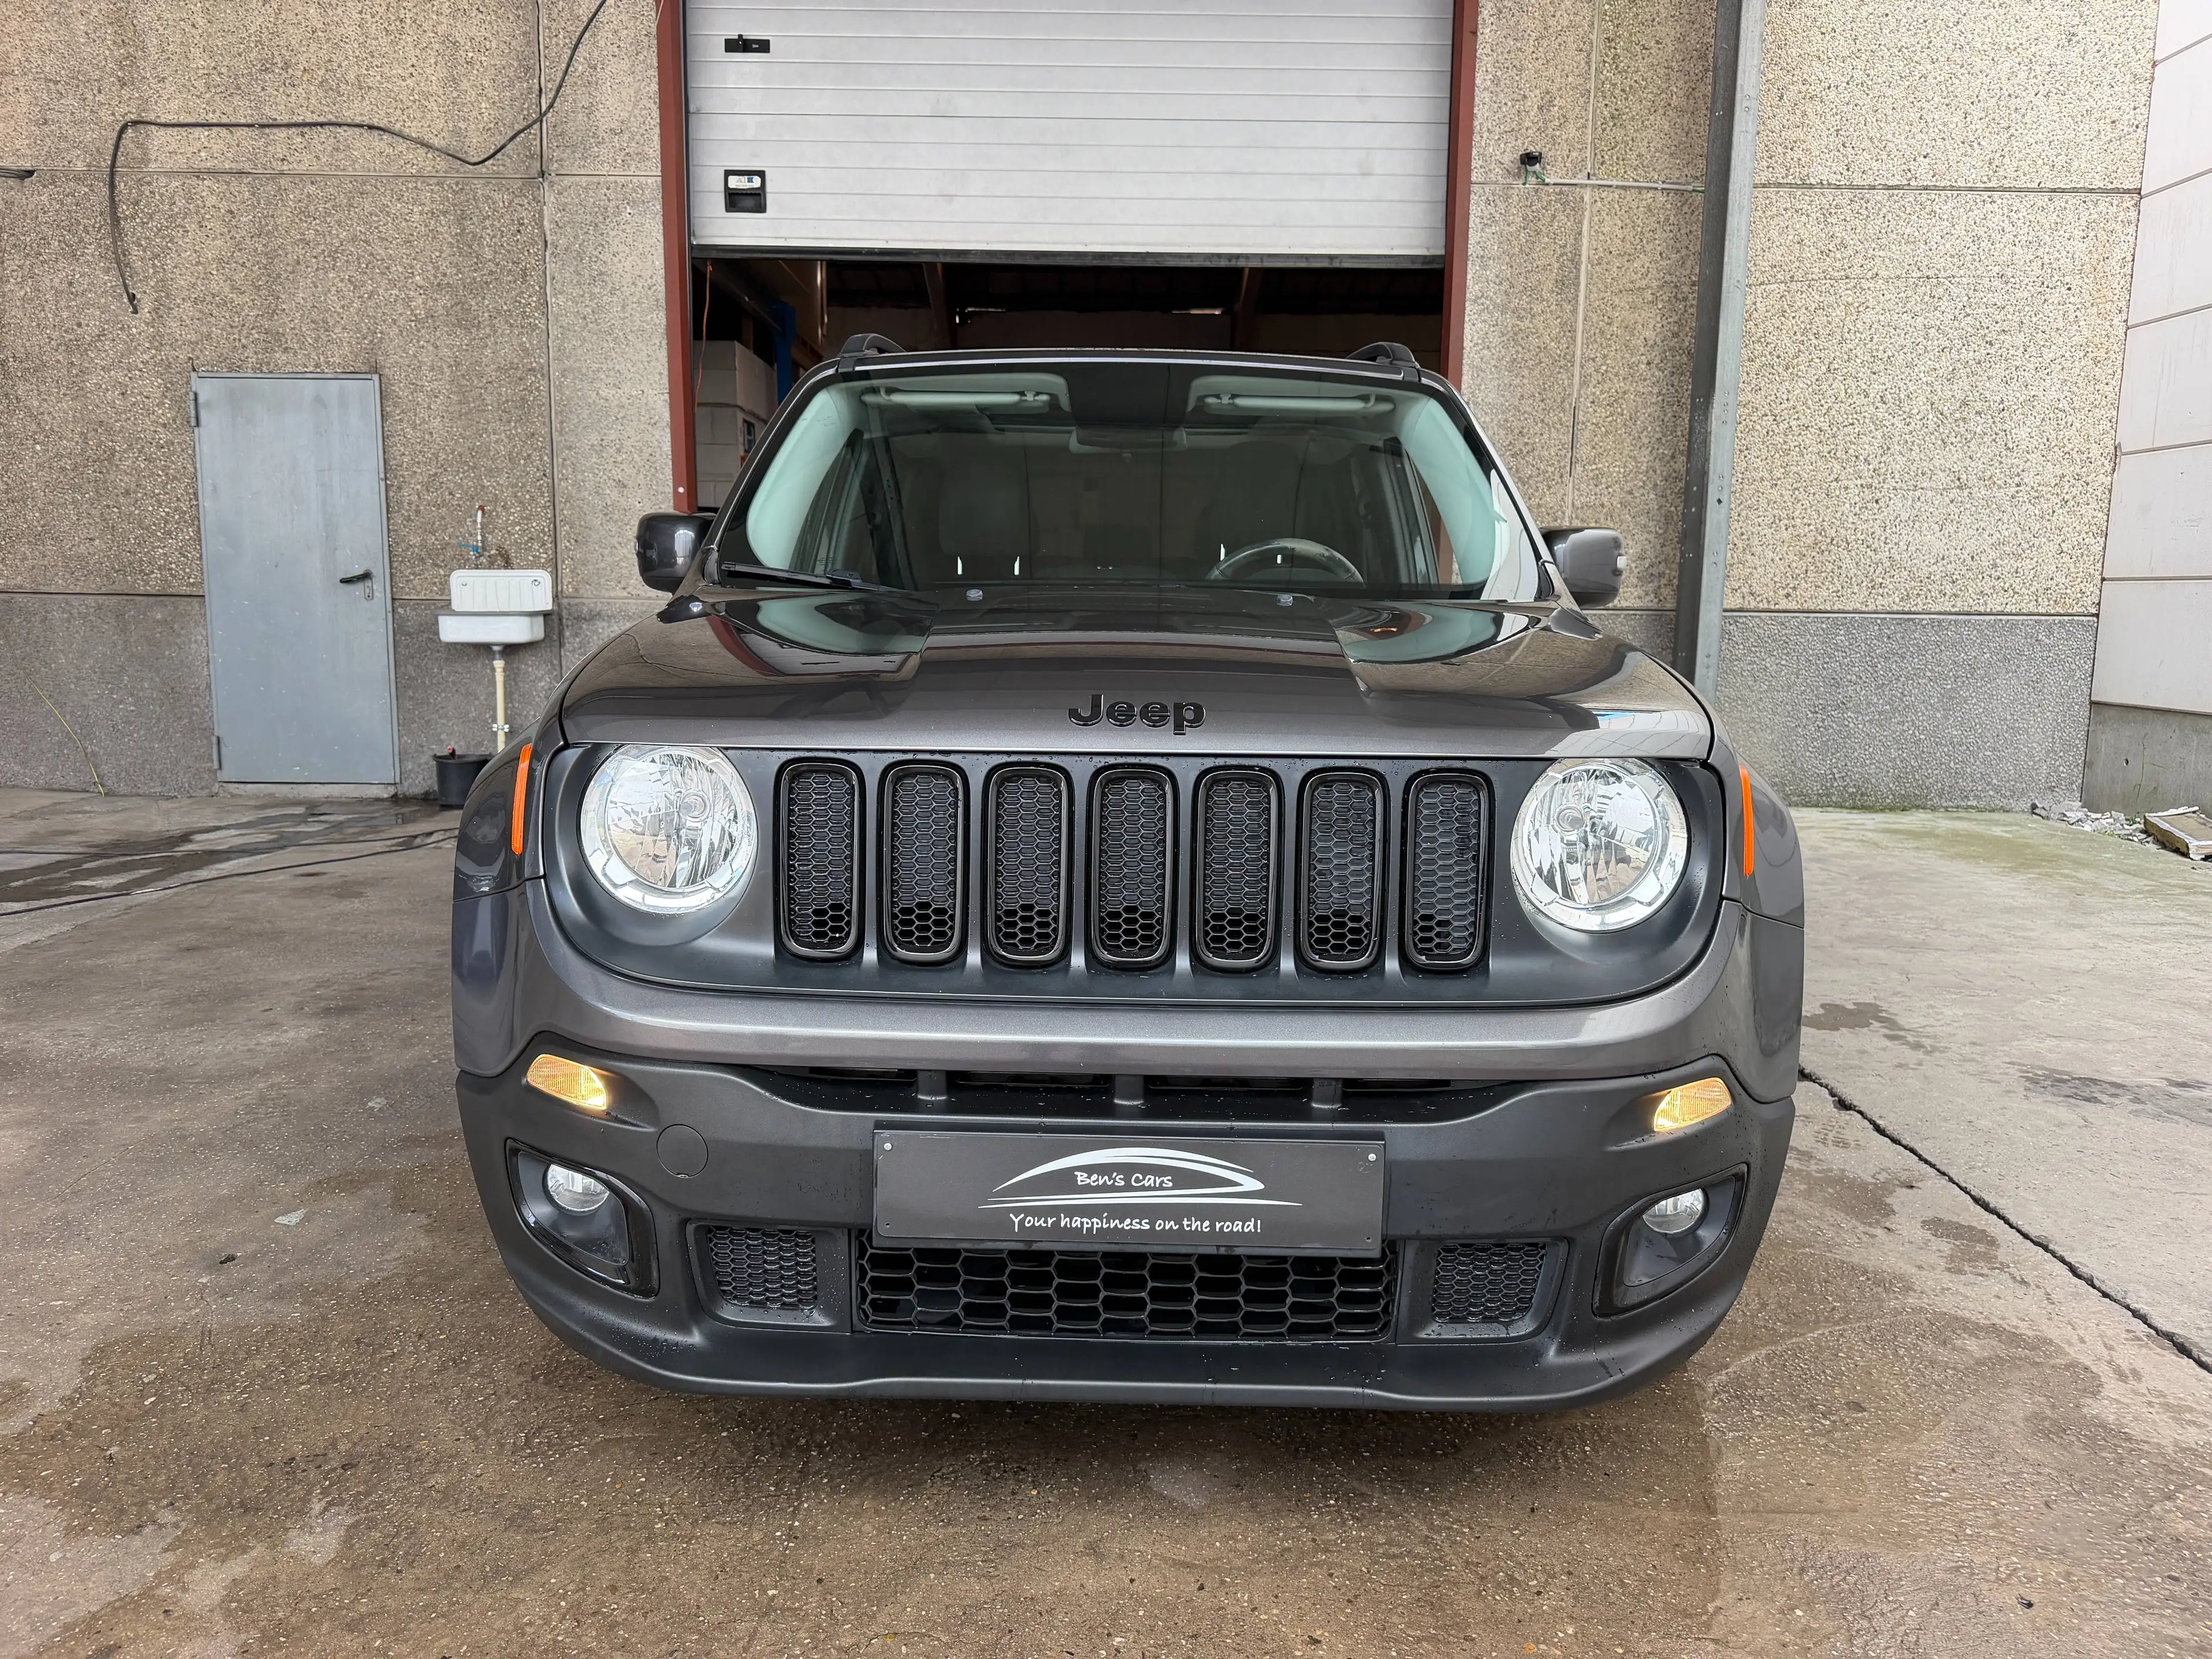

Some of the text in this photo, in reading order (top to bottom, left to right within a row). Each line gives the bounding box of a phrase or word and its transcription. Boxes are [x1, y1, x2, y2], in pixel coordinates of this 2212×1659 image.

[1068, 694, 1206, 736] Jeep
[1074, 1171, 1173, 1188] Ben's Cars
[1009, 1212, 1261, 1234] Your happiness on the road!
